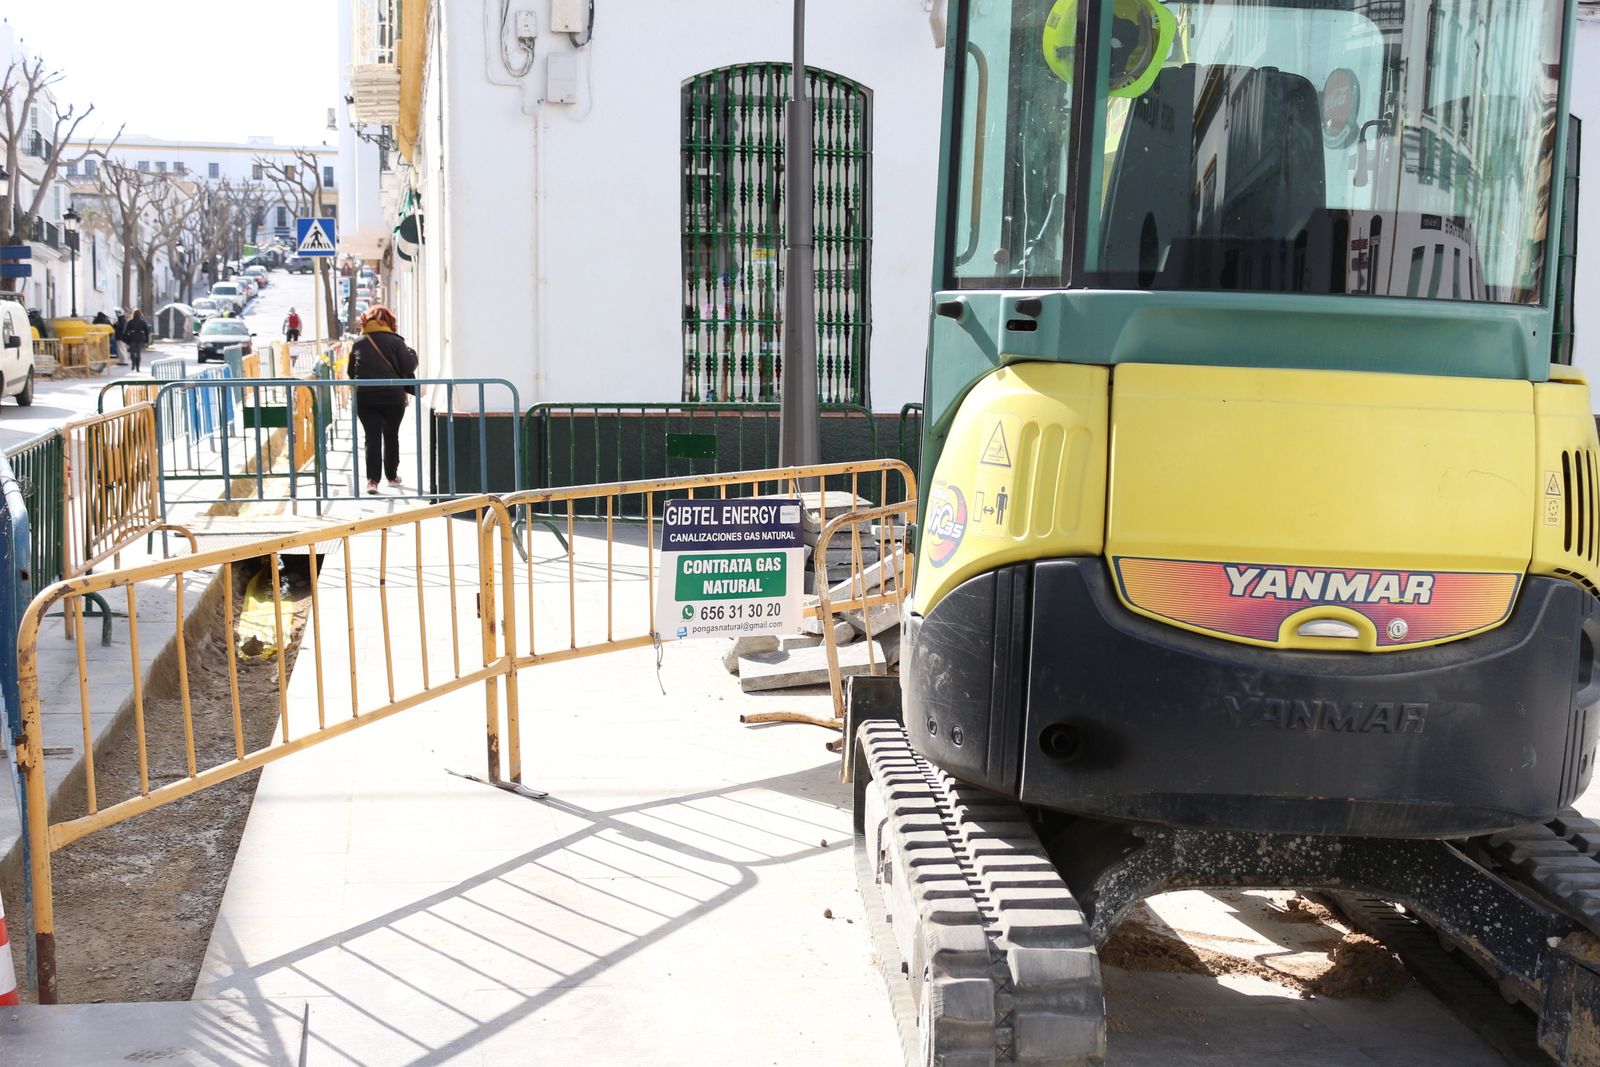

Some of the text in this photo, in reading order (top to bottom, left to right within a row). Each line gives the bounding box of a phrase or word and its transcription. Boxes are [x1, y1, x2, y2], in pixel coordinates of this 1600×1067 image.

[666, 506, 718, 526] GIBTEL
[722, 506, 777, 525] ENERGY
[669, 531, 795, 542] CANALIZACIONES GAS NATURAL
[683, 557, 781, 574] CONTRATA GAS
[703, 579, 762, 594] NATURAL
[1225, 565, 1435, 604] YANMAR
[700, 602, 781, 620] 656 31 30 20
[692, 621, 782, 633] pongasnatural@gmail.com
[1224, 696, 1429, 734] YANMAR
